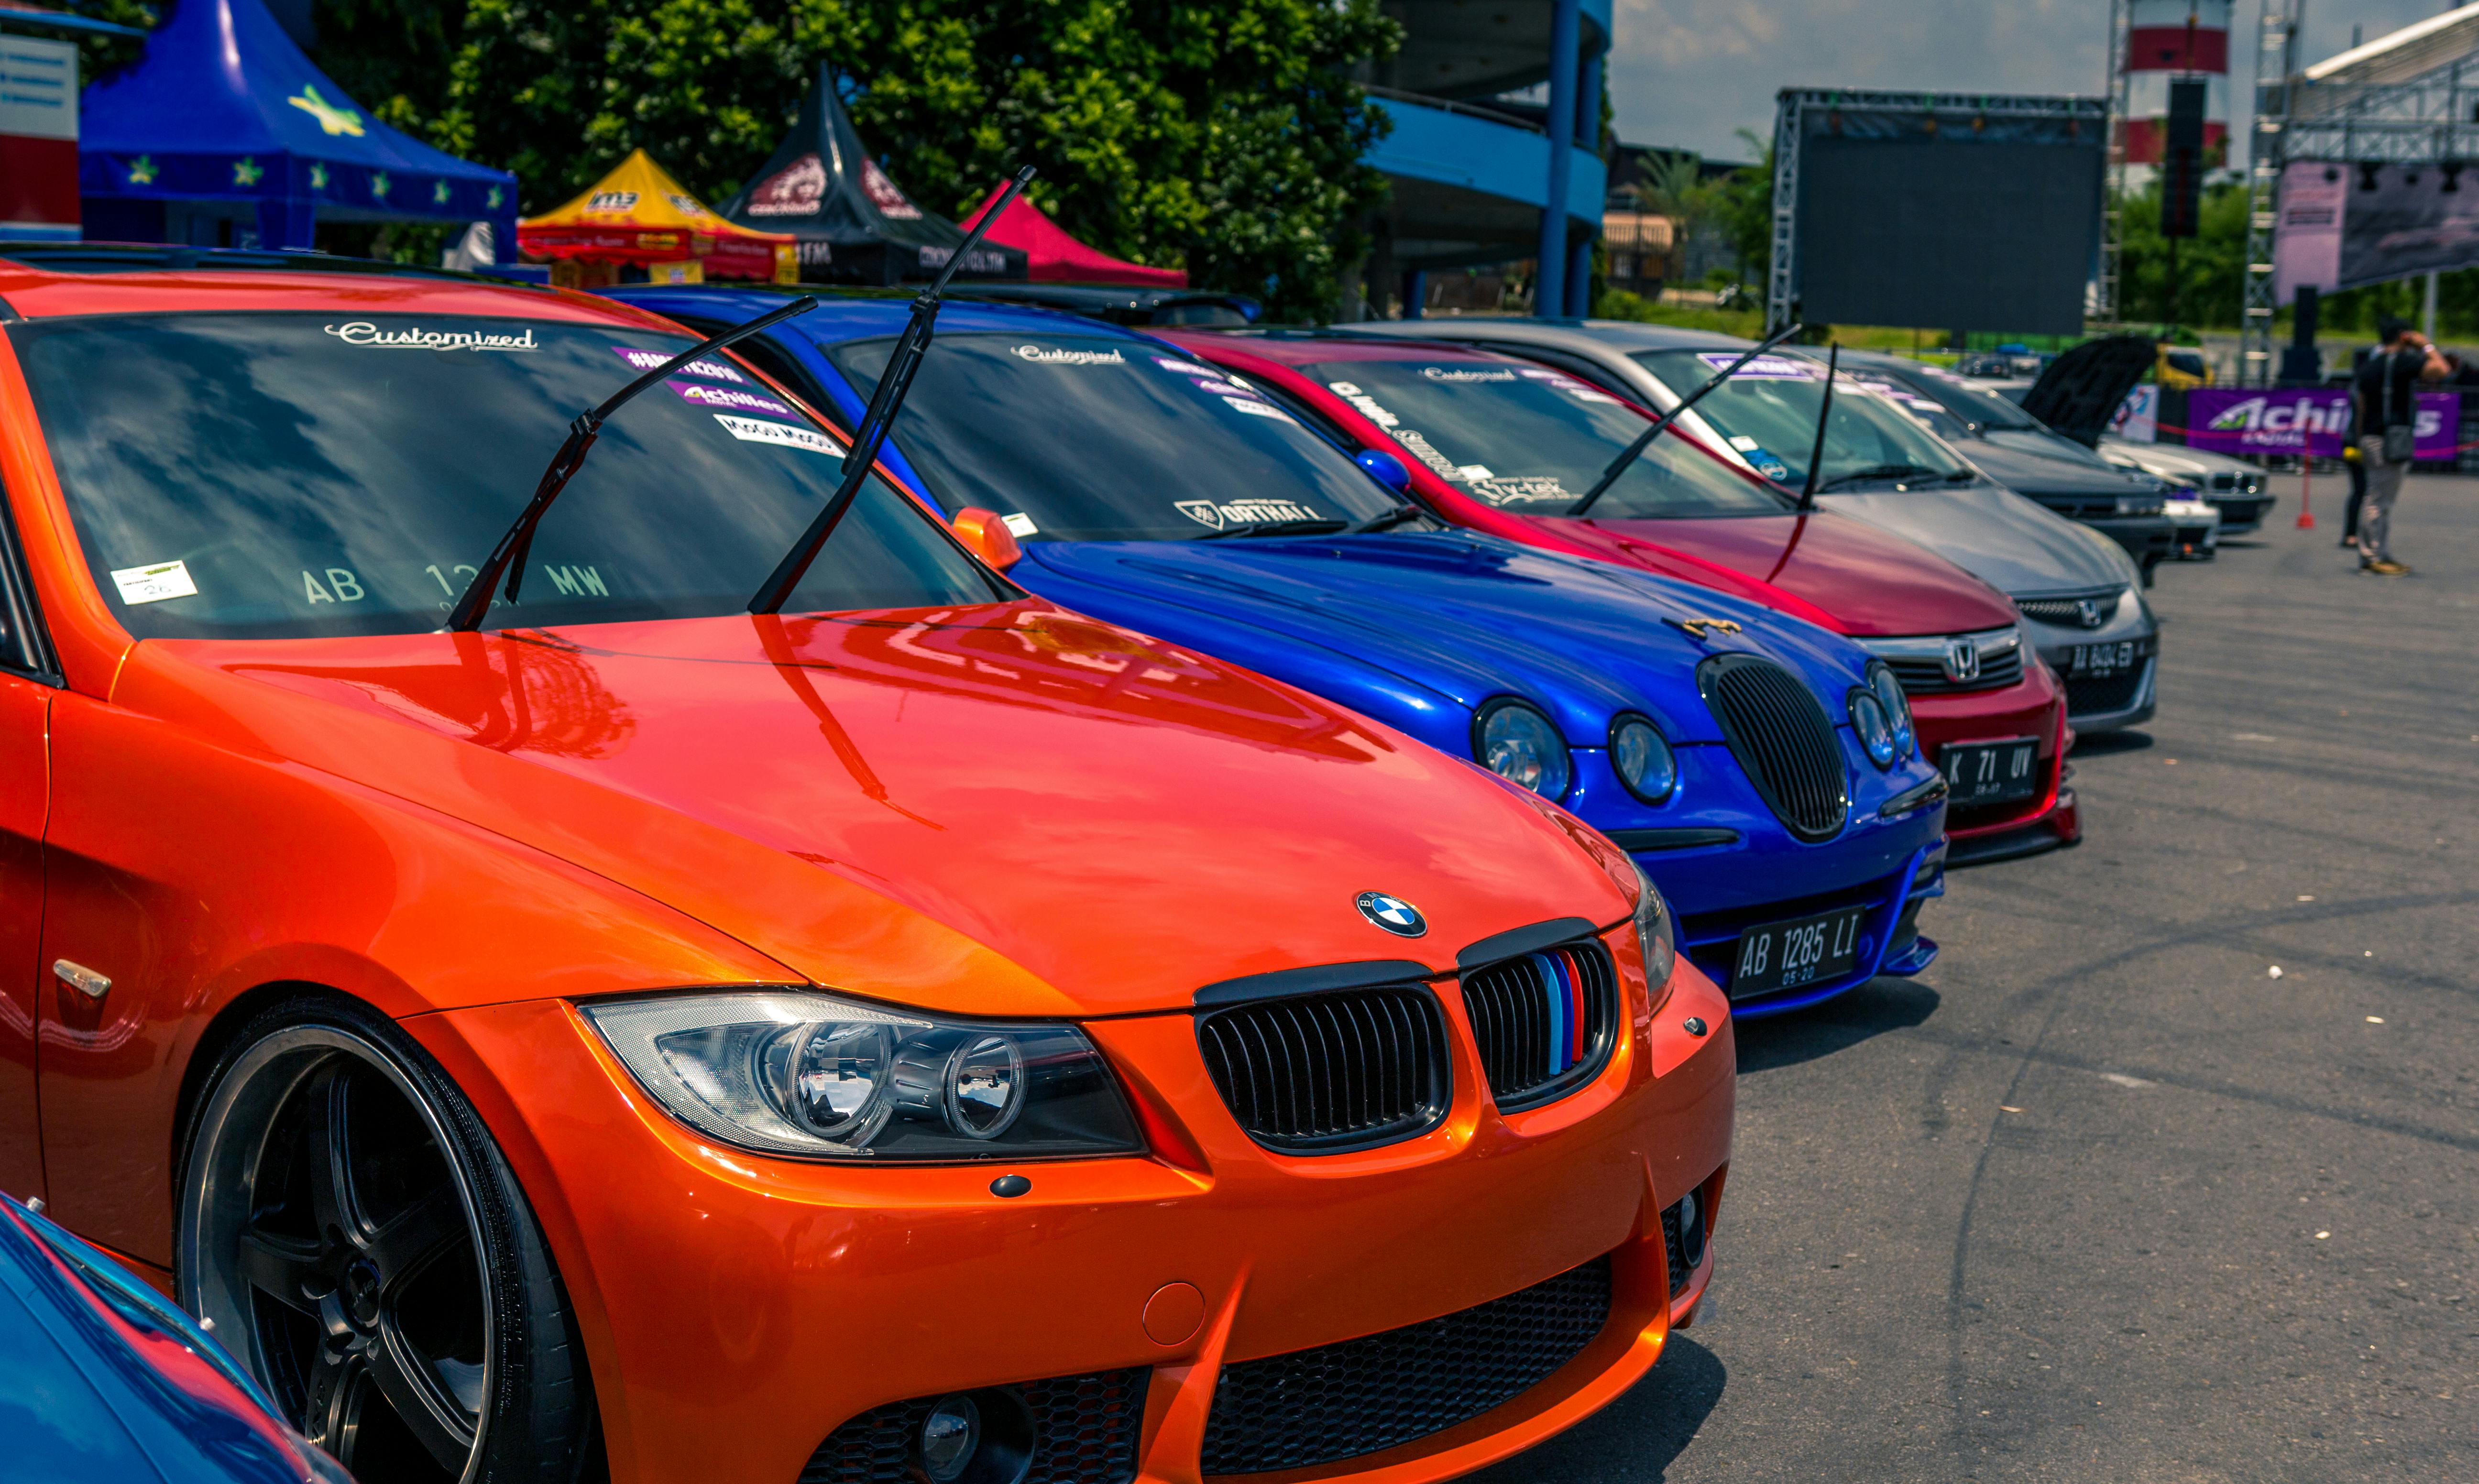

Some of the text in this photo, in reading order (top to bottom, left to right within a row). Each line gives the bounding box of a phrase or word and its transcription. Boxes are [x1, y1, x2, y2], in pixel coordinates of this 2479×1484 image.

[324, 322, 541, 351] Customized
[684, 386, 788, 414] Achilles
[2207, 396, 2443, 438] Achis
[302, 568, 364, 605] AB
[544, 564, 609, 597] MW
[1949, 752, 1963, 785] K
[1977, 749, 1996, 782] 71
[1360, 893, 1402, 907] BMW
[1739, 914, 1859, 979] AB 1285 LI
